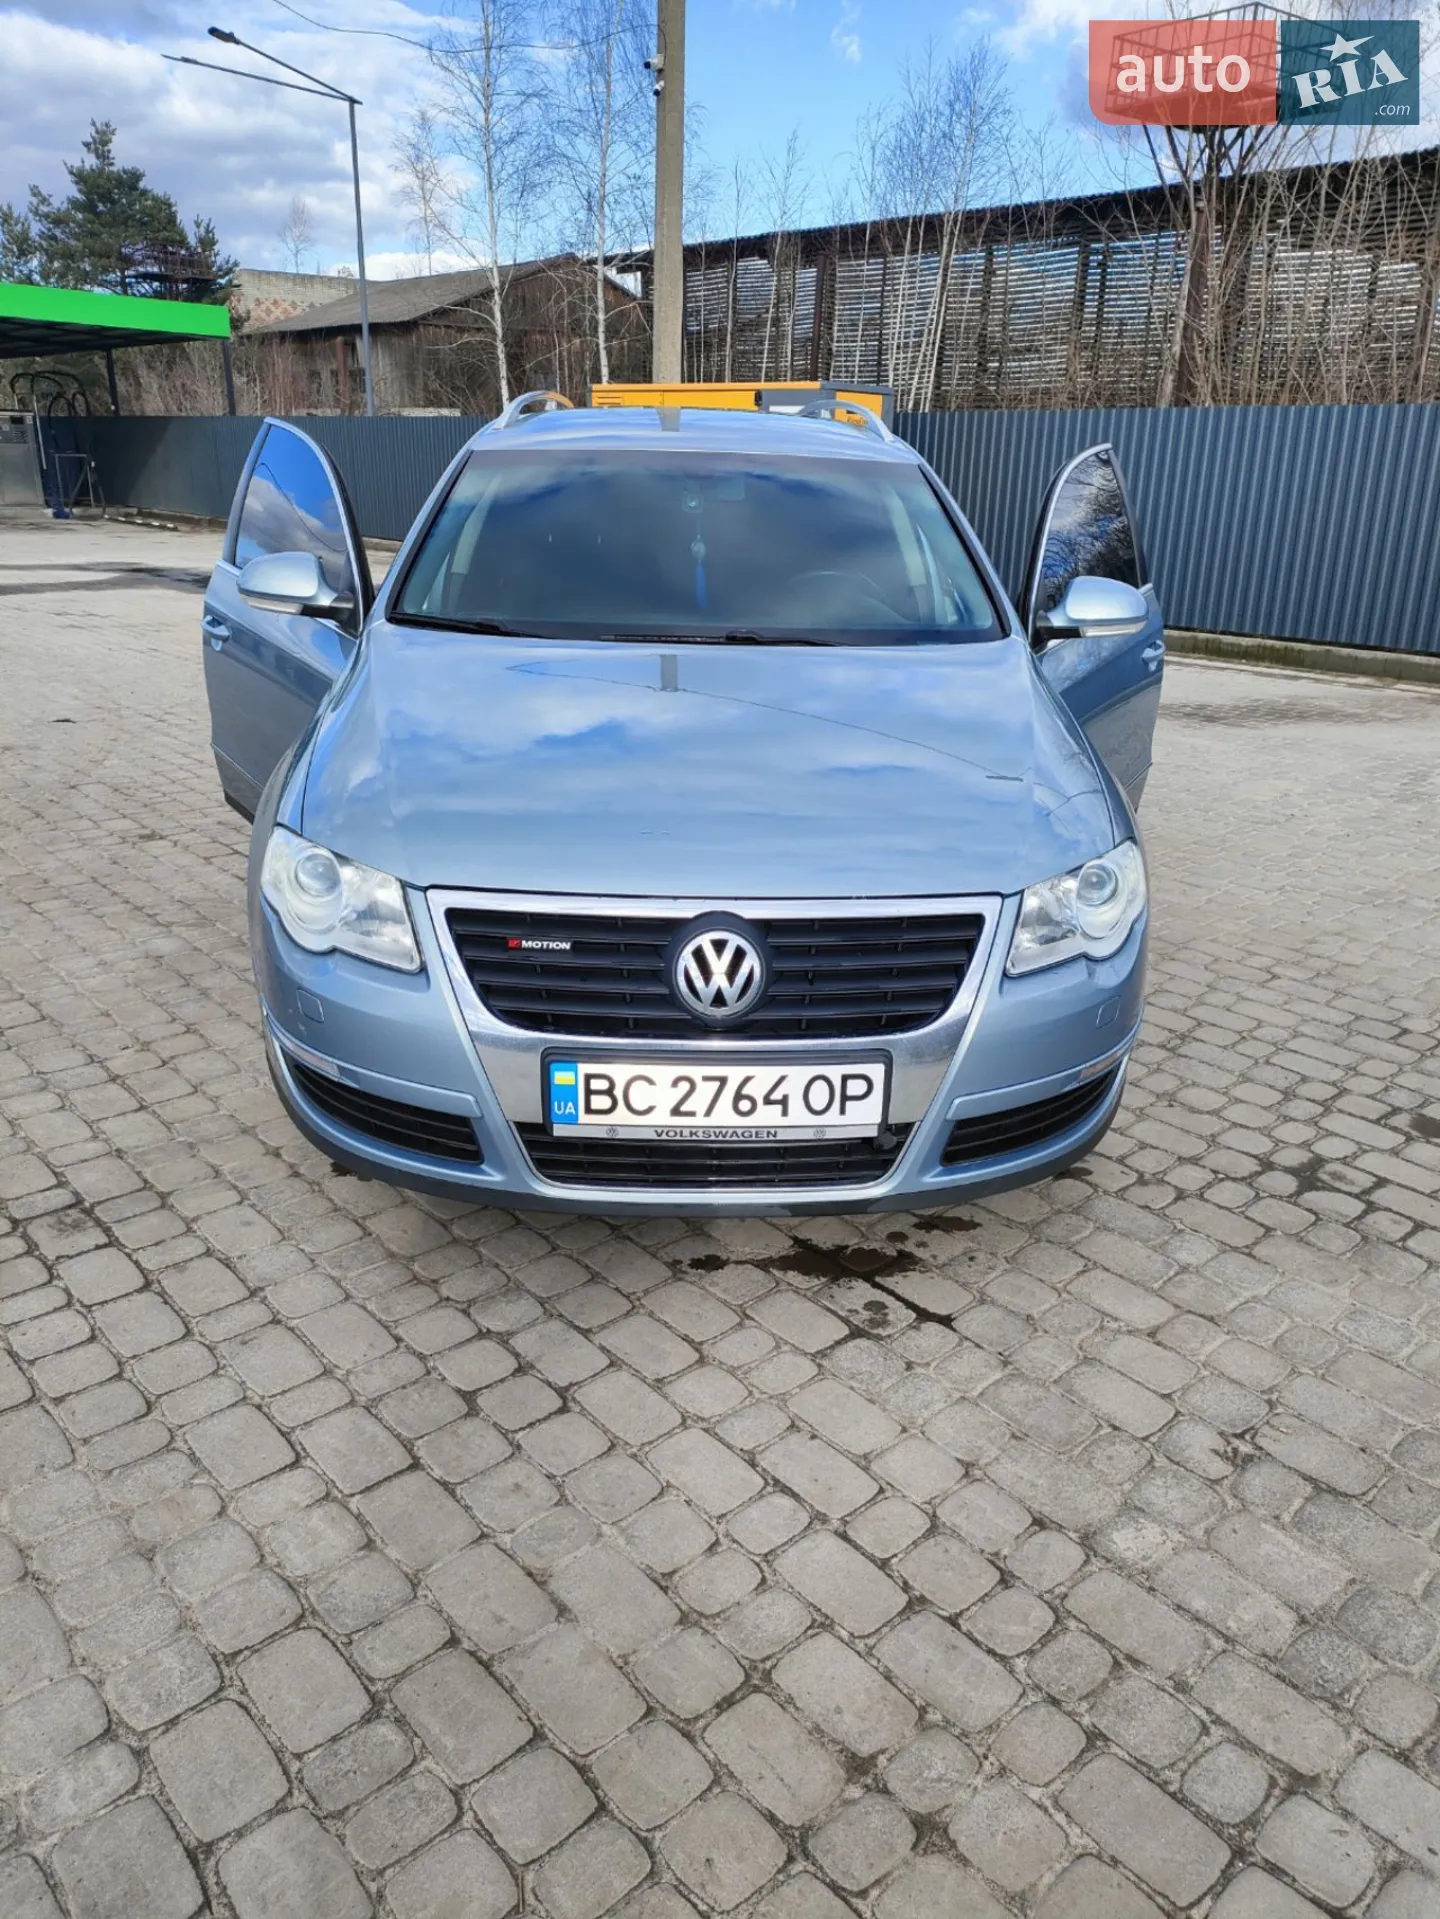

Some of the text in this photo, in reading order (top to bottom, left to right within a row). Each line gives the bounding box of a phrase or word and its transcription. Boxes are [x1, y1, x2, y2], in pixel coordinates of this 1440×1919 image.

[584, 1073, 875, 1118] BC 2764 OP
[554, 1101, 576, 1116] UA
[653, 1128, 779, 1139] VOLKSWAGEN
